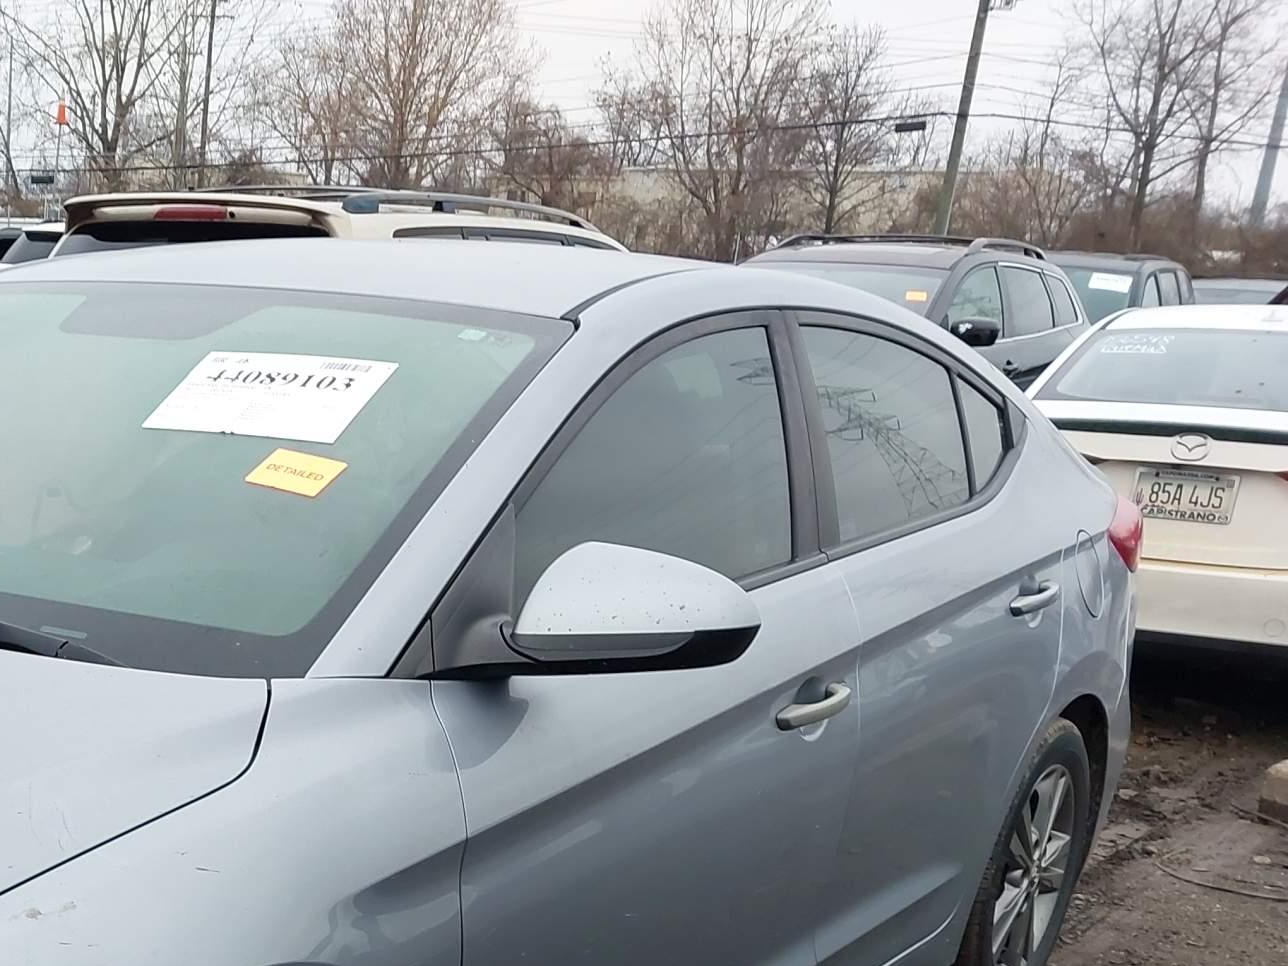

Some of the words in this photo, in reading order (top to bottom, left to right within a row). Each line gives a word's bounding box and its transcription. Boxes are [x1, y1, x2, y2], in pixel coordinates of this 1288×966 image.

[206, 369, 355, 392] 44089103
[265, 463, 324, 481] DETAILED
[1148, 481, 1184, 506] 85A
[1188, 484, 1225, 509] 4JS
[1140, 505, 1216, 522] CAPISTRANO
